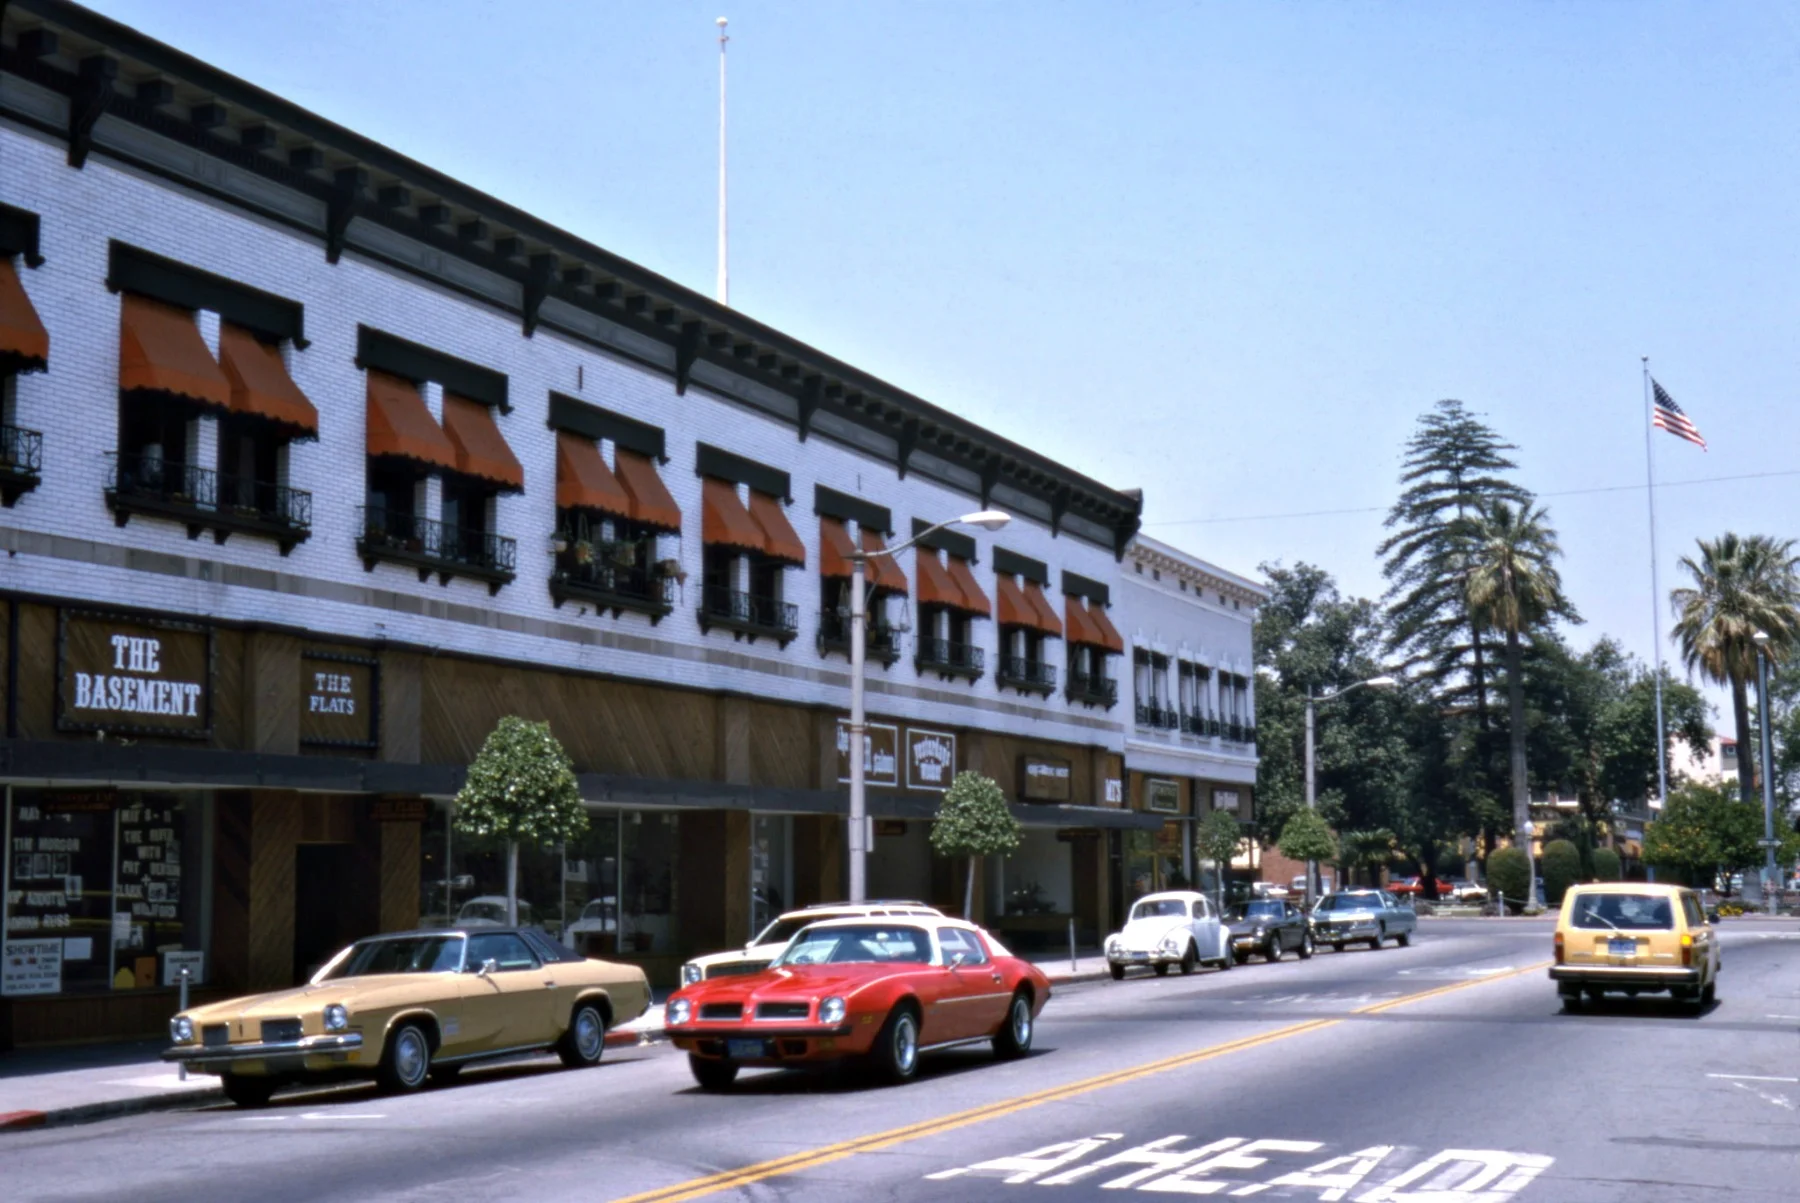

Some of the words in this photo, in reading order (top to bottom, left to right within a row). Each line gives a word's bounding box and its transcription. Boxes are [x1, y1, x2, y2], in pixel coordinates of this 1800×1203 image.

[111, 635, 160, 673] THE
[74, 672, 201, 717] BASEMENT
[315, 672, 352, 693] THE
[309, 695, 355, 716] FLATS
[924, 1132, 1557, 1203] AHEAD
